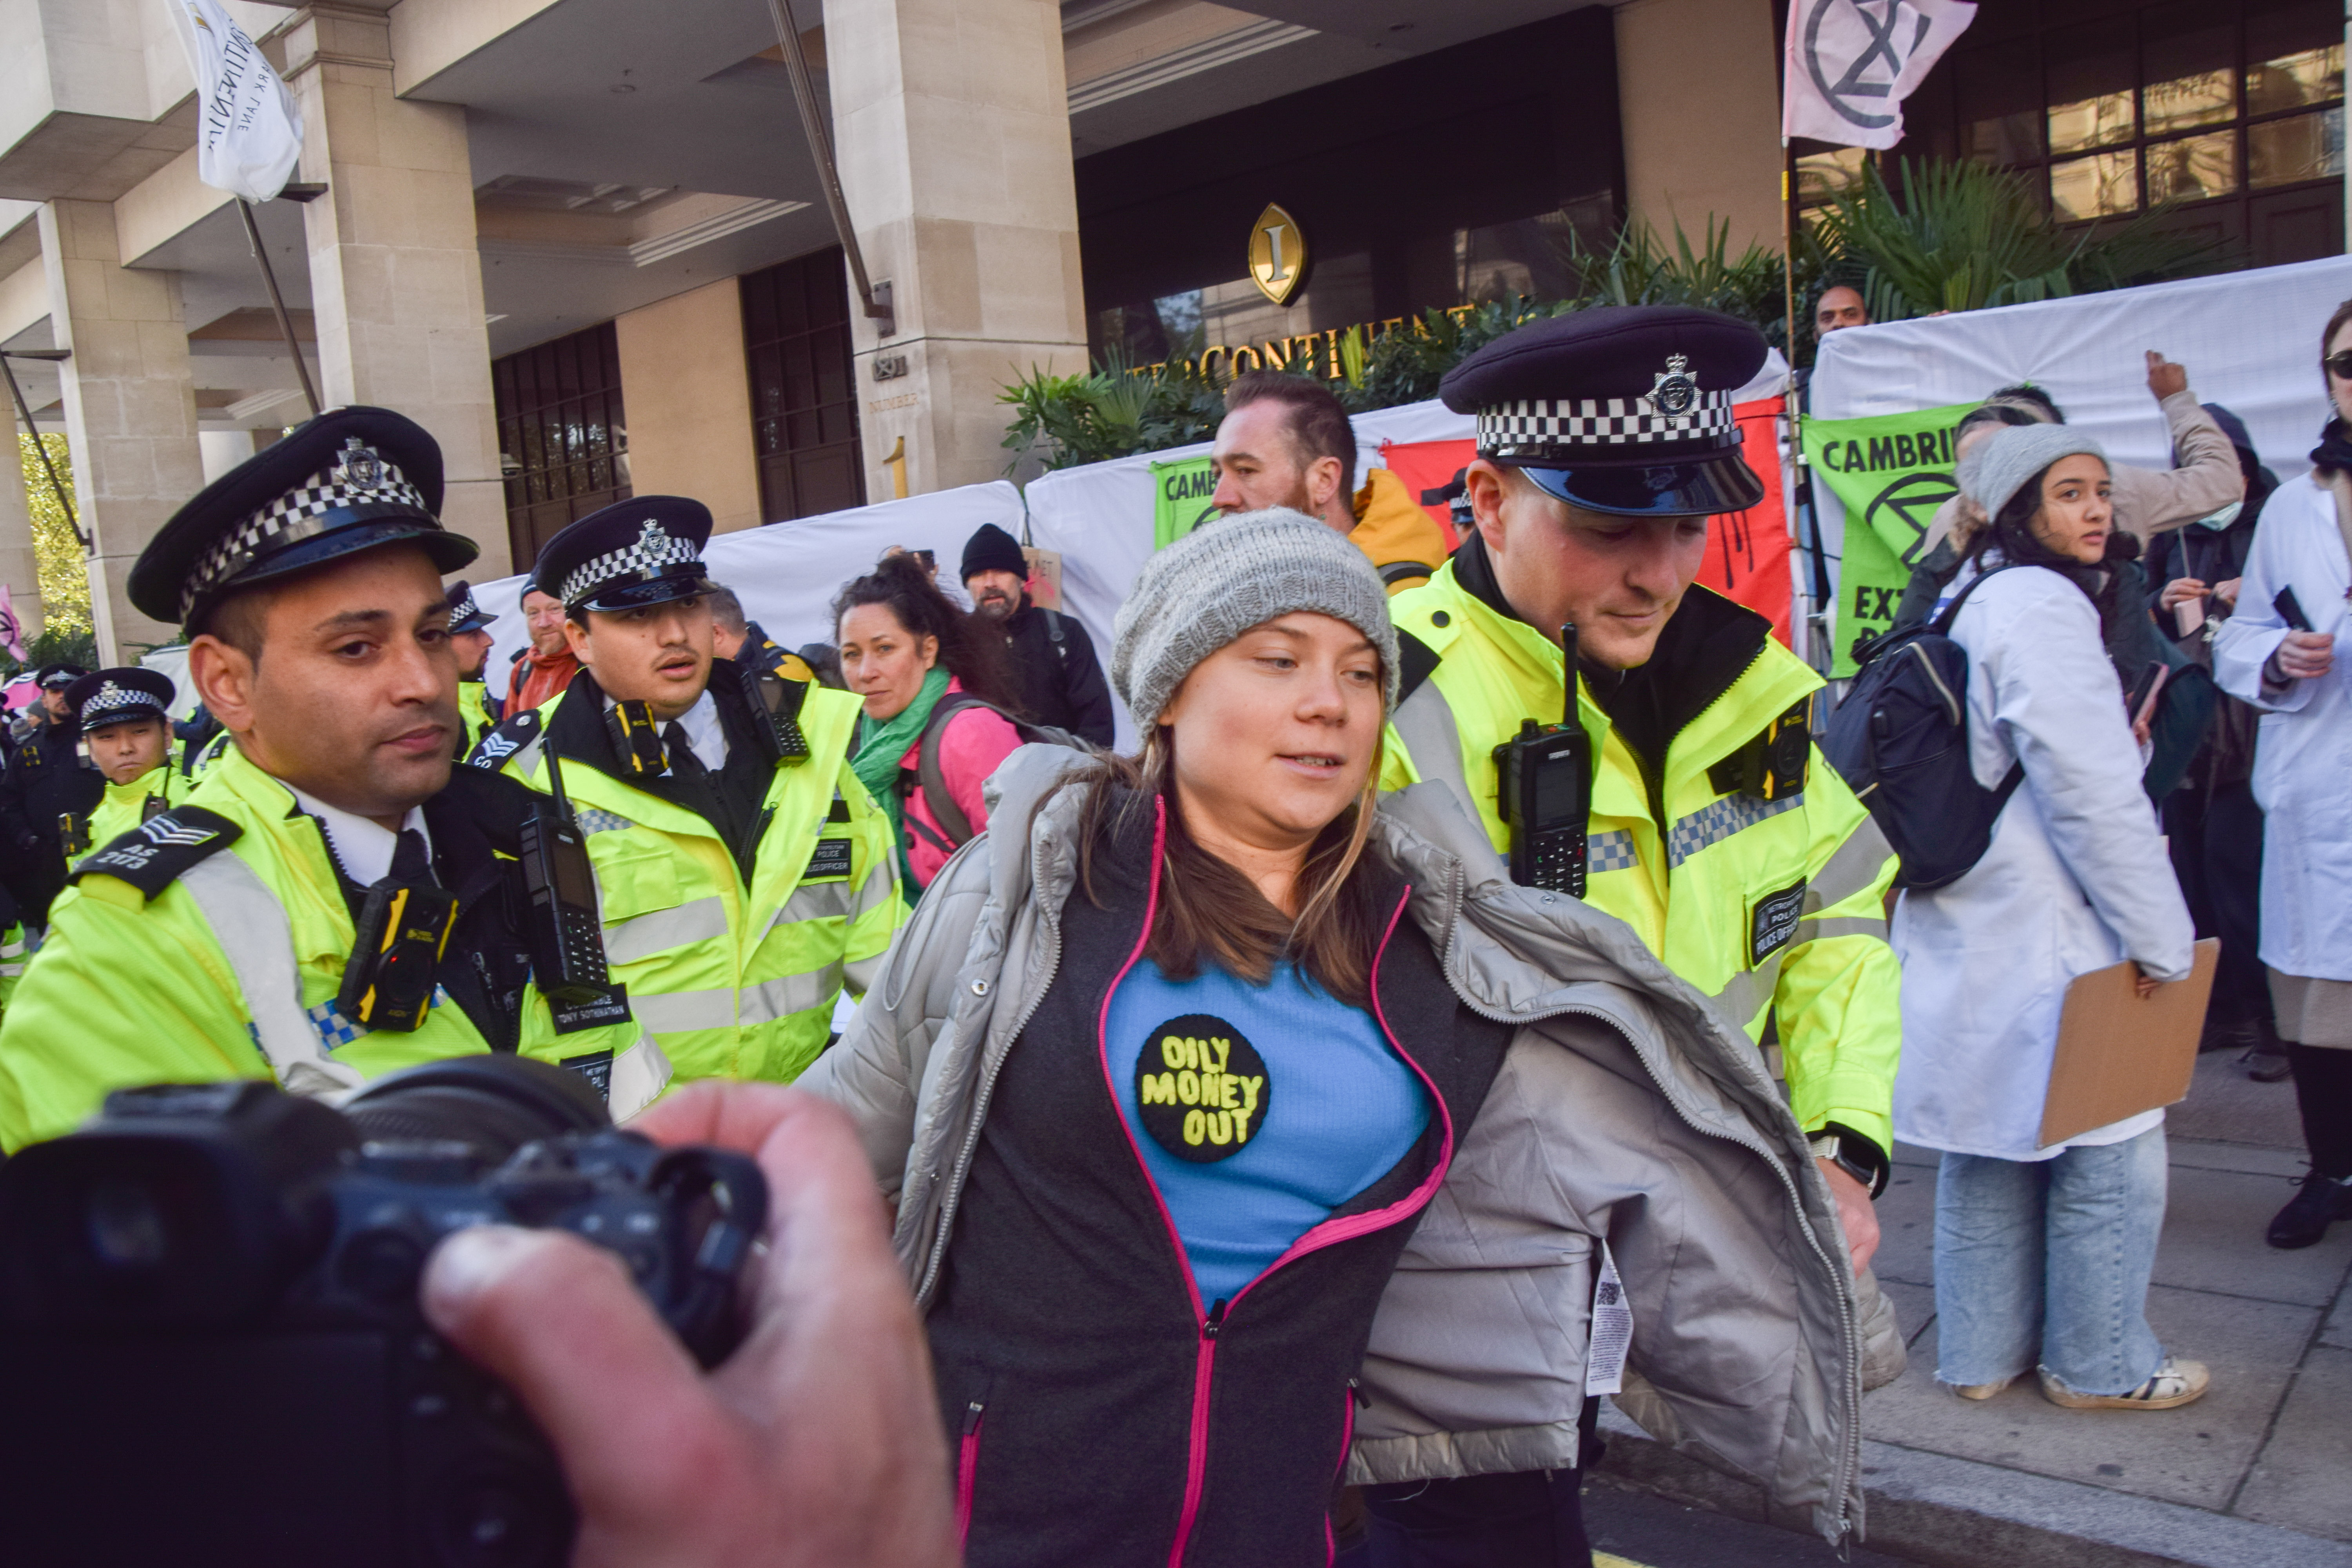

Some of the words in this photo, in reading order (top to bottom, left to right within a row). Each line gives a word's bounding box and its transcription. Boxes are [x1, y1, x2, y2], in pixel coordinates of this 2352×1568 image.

[1823, 427, 1956, 473] CAMBRI
[122, 844, 159, 857] AS
[817, 849, 840, 858] POLICE
[1771, 904, 1798, 924] POLICE
[1161, 1035, 1230, 1073] OILY
[1142, 1070, 1264, 1111] MONEY
[1183, 1109, 1252, 1146] OUT
